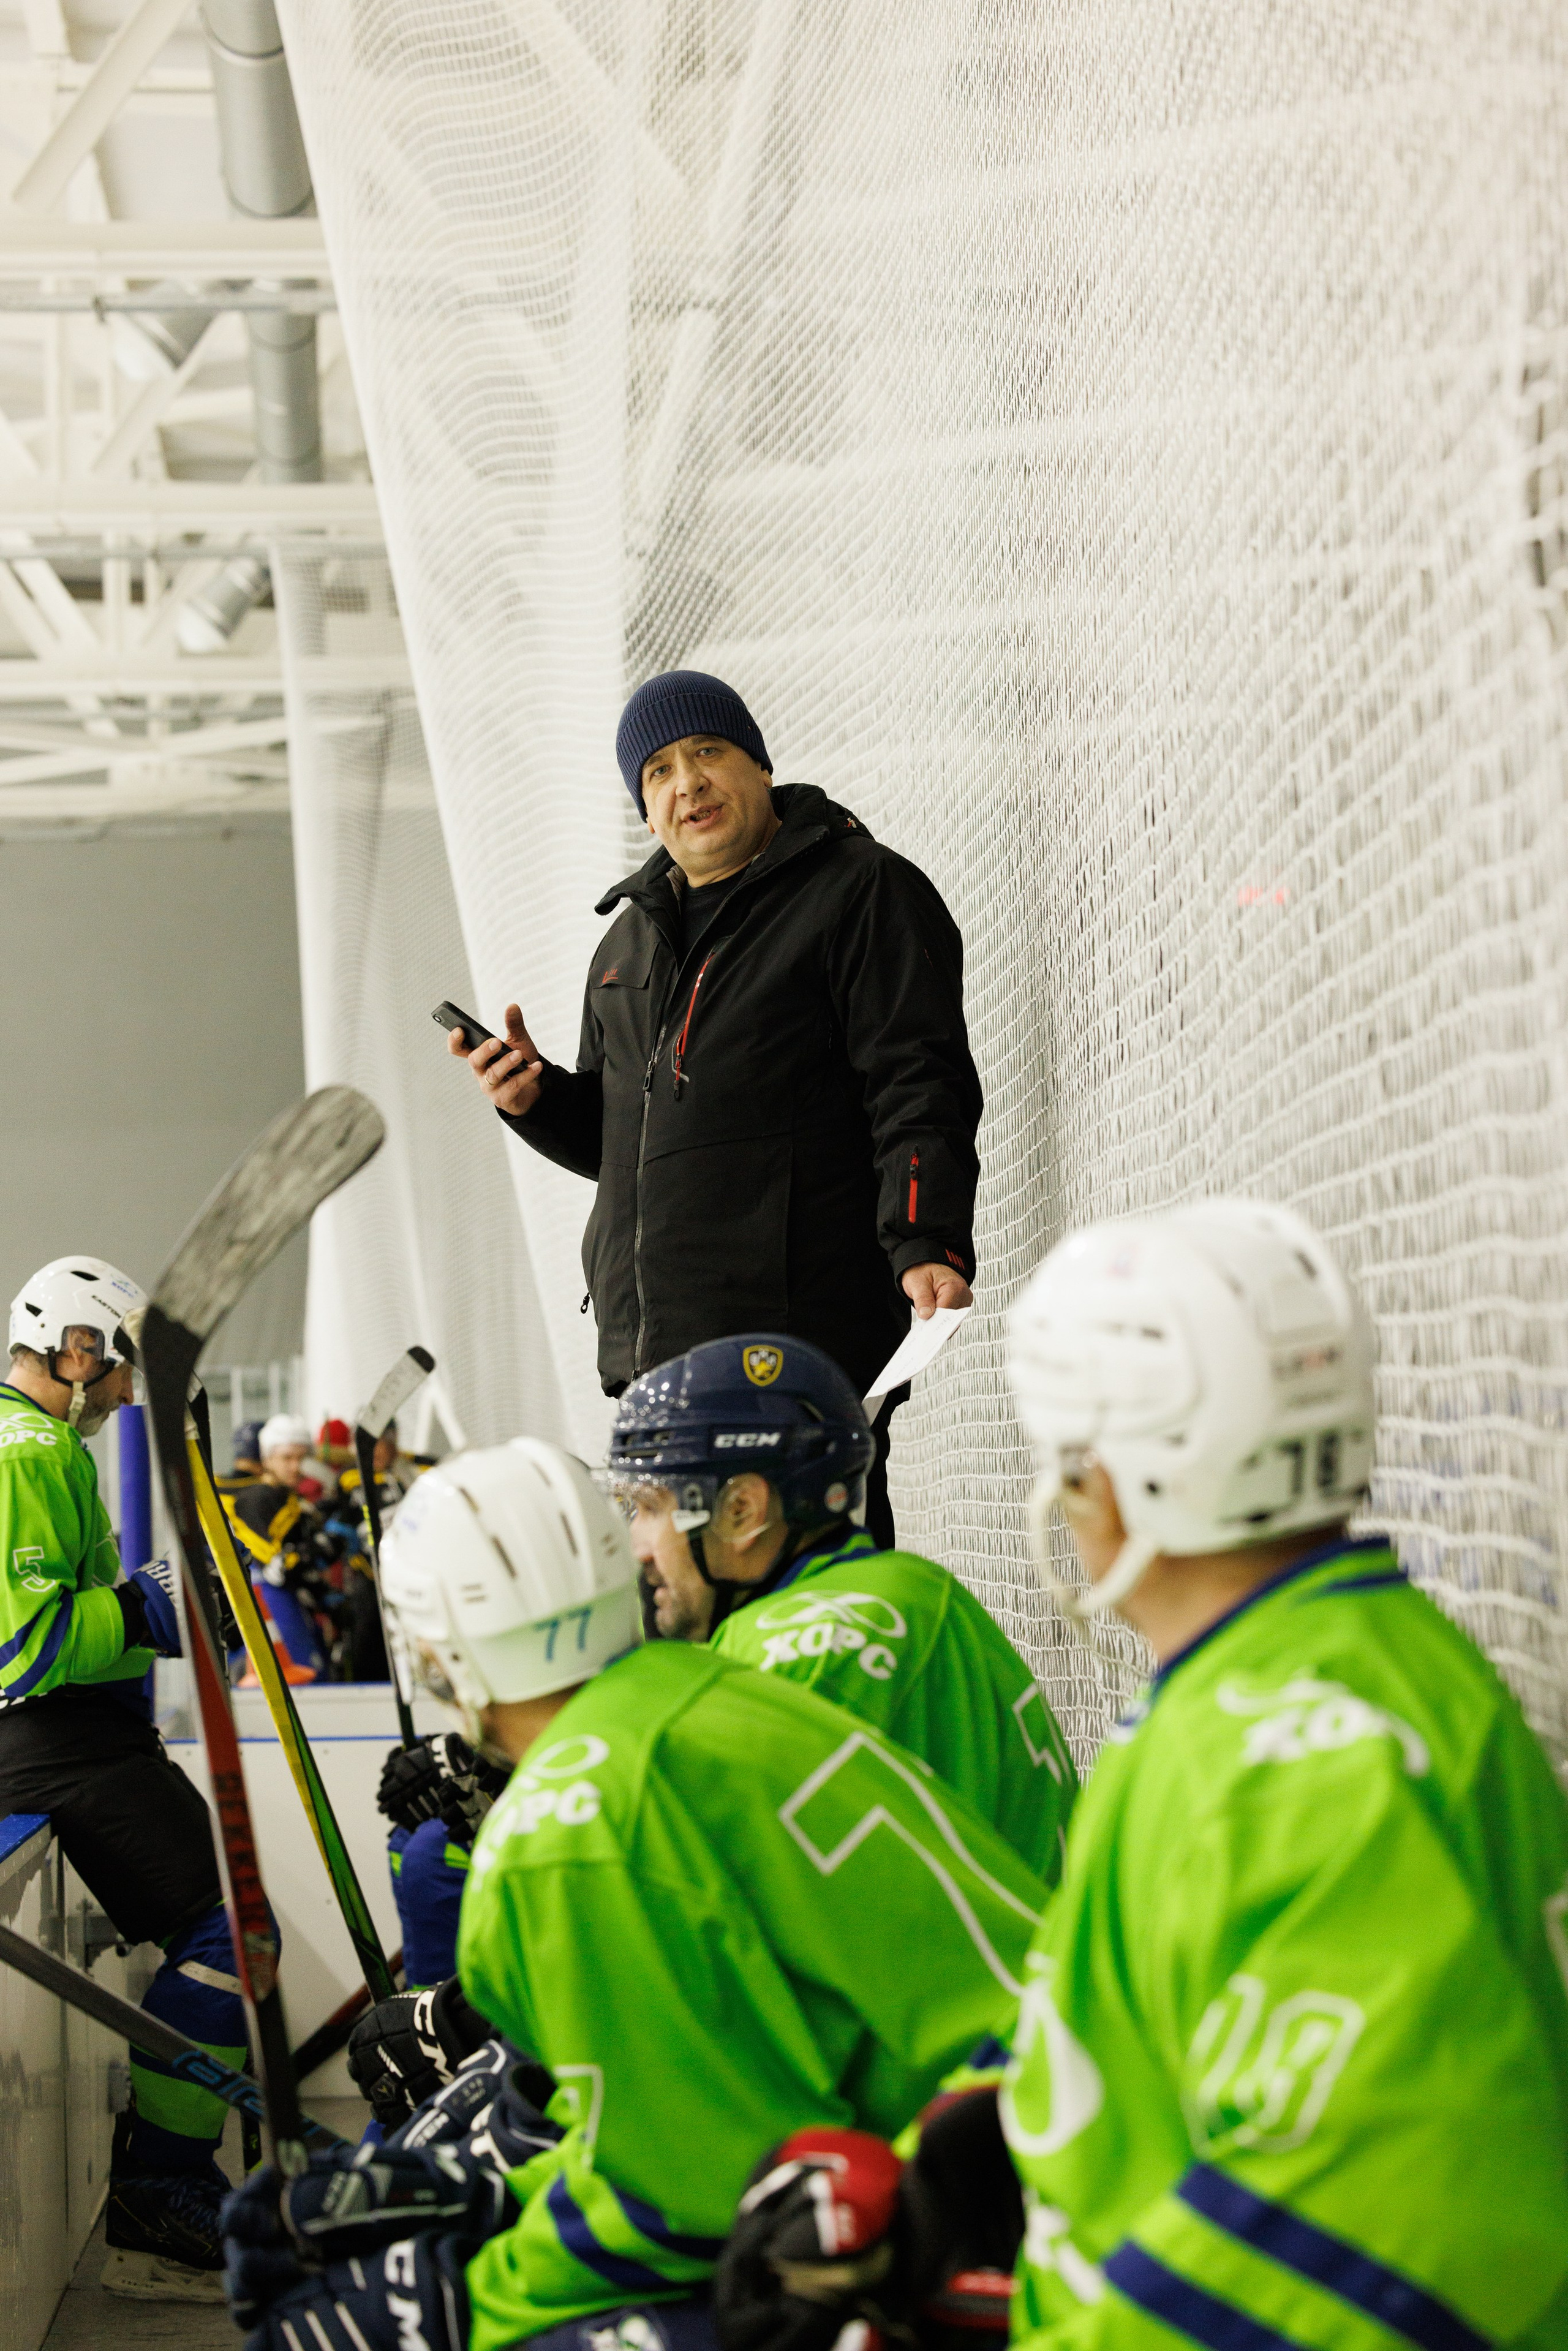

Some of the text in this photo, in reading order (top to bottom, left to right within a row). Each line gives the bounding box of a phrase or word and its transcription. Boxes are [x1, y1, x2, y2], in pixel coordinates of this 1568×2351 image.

[0, 1429, 58, 1448] ОРС
[714, 1432, 782, 1449] CCM
[13, 1545, 56, 1593] 5
[532, 1603, 593, 1664] 77
[759, 1621, 898, 1680] ХОРС
[413, 1990, 455, 2086] CM
